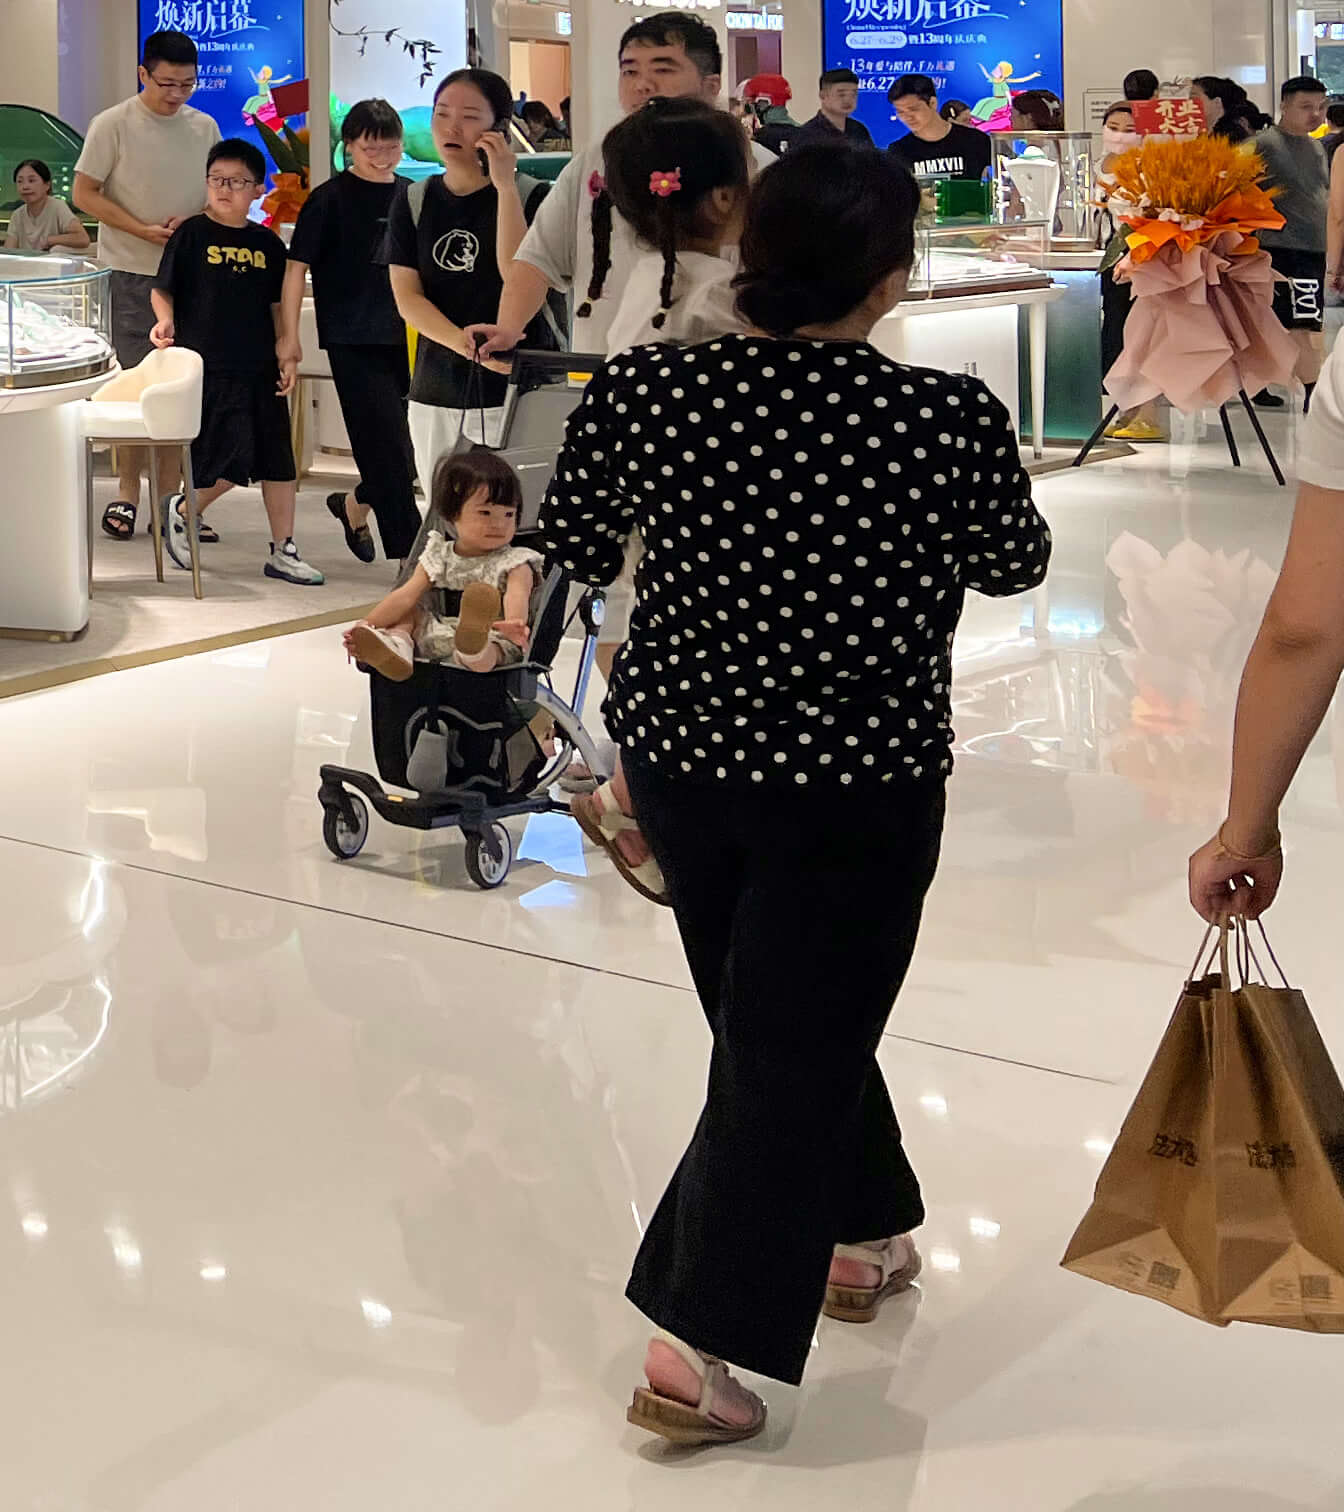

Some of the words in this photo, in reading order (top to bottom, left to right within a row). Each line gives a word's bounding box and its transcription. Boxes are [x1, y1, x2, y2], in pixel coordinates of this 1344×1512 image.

[1155, 98, 1202, 119] 开业
[1159, 117, 1203, 136] 大吉
[913, 156, 965, 177] MMXVII
